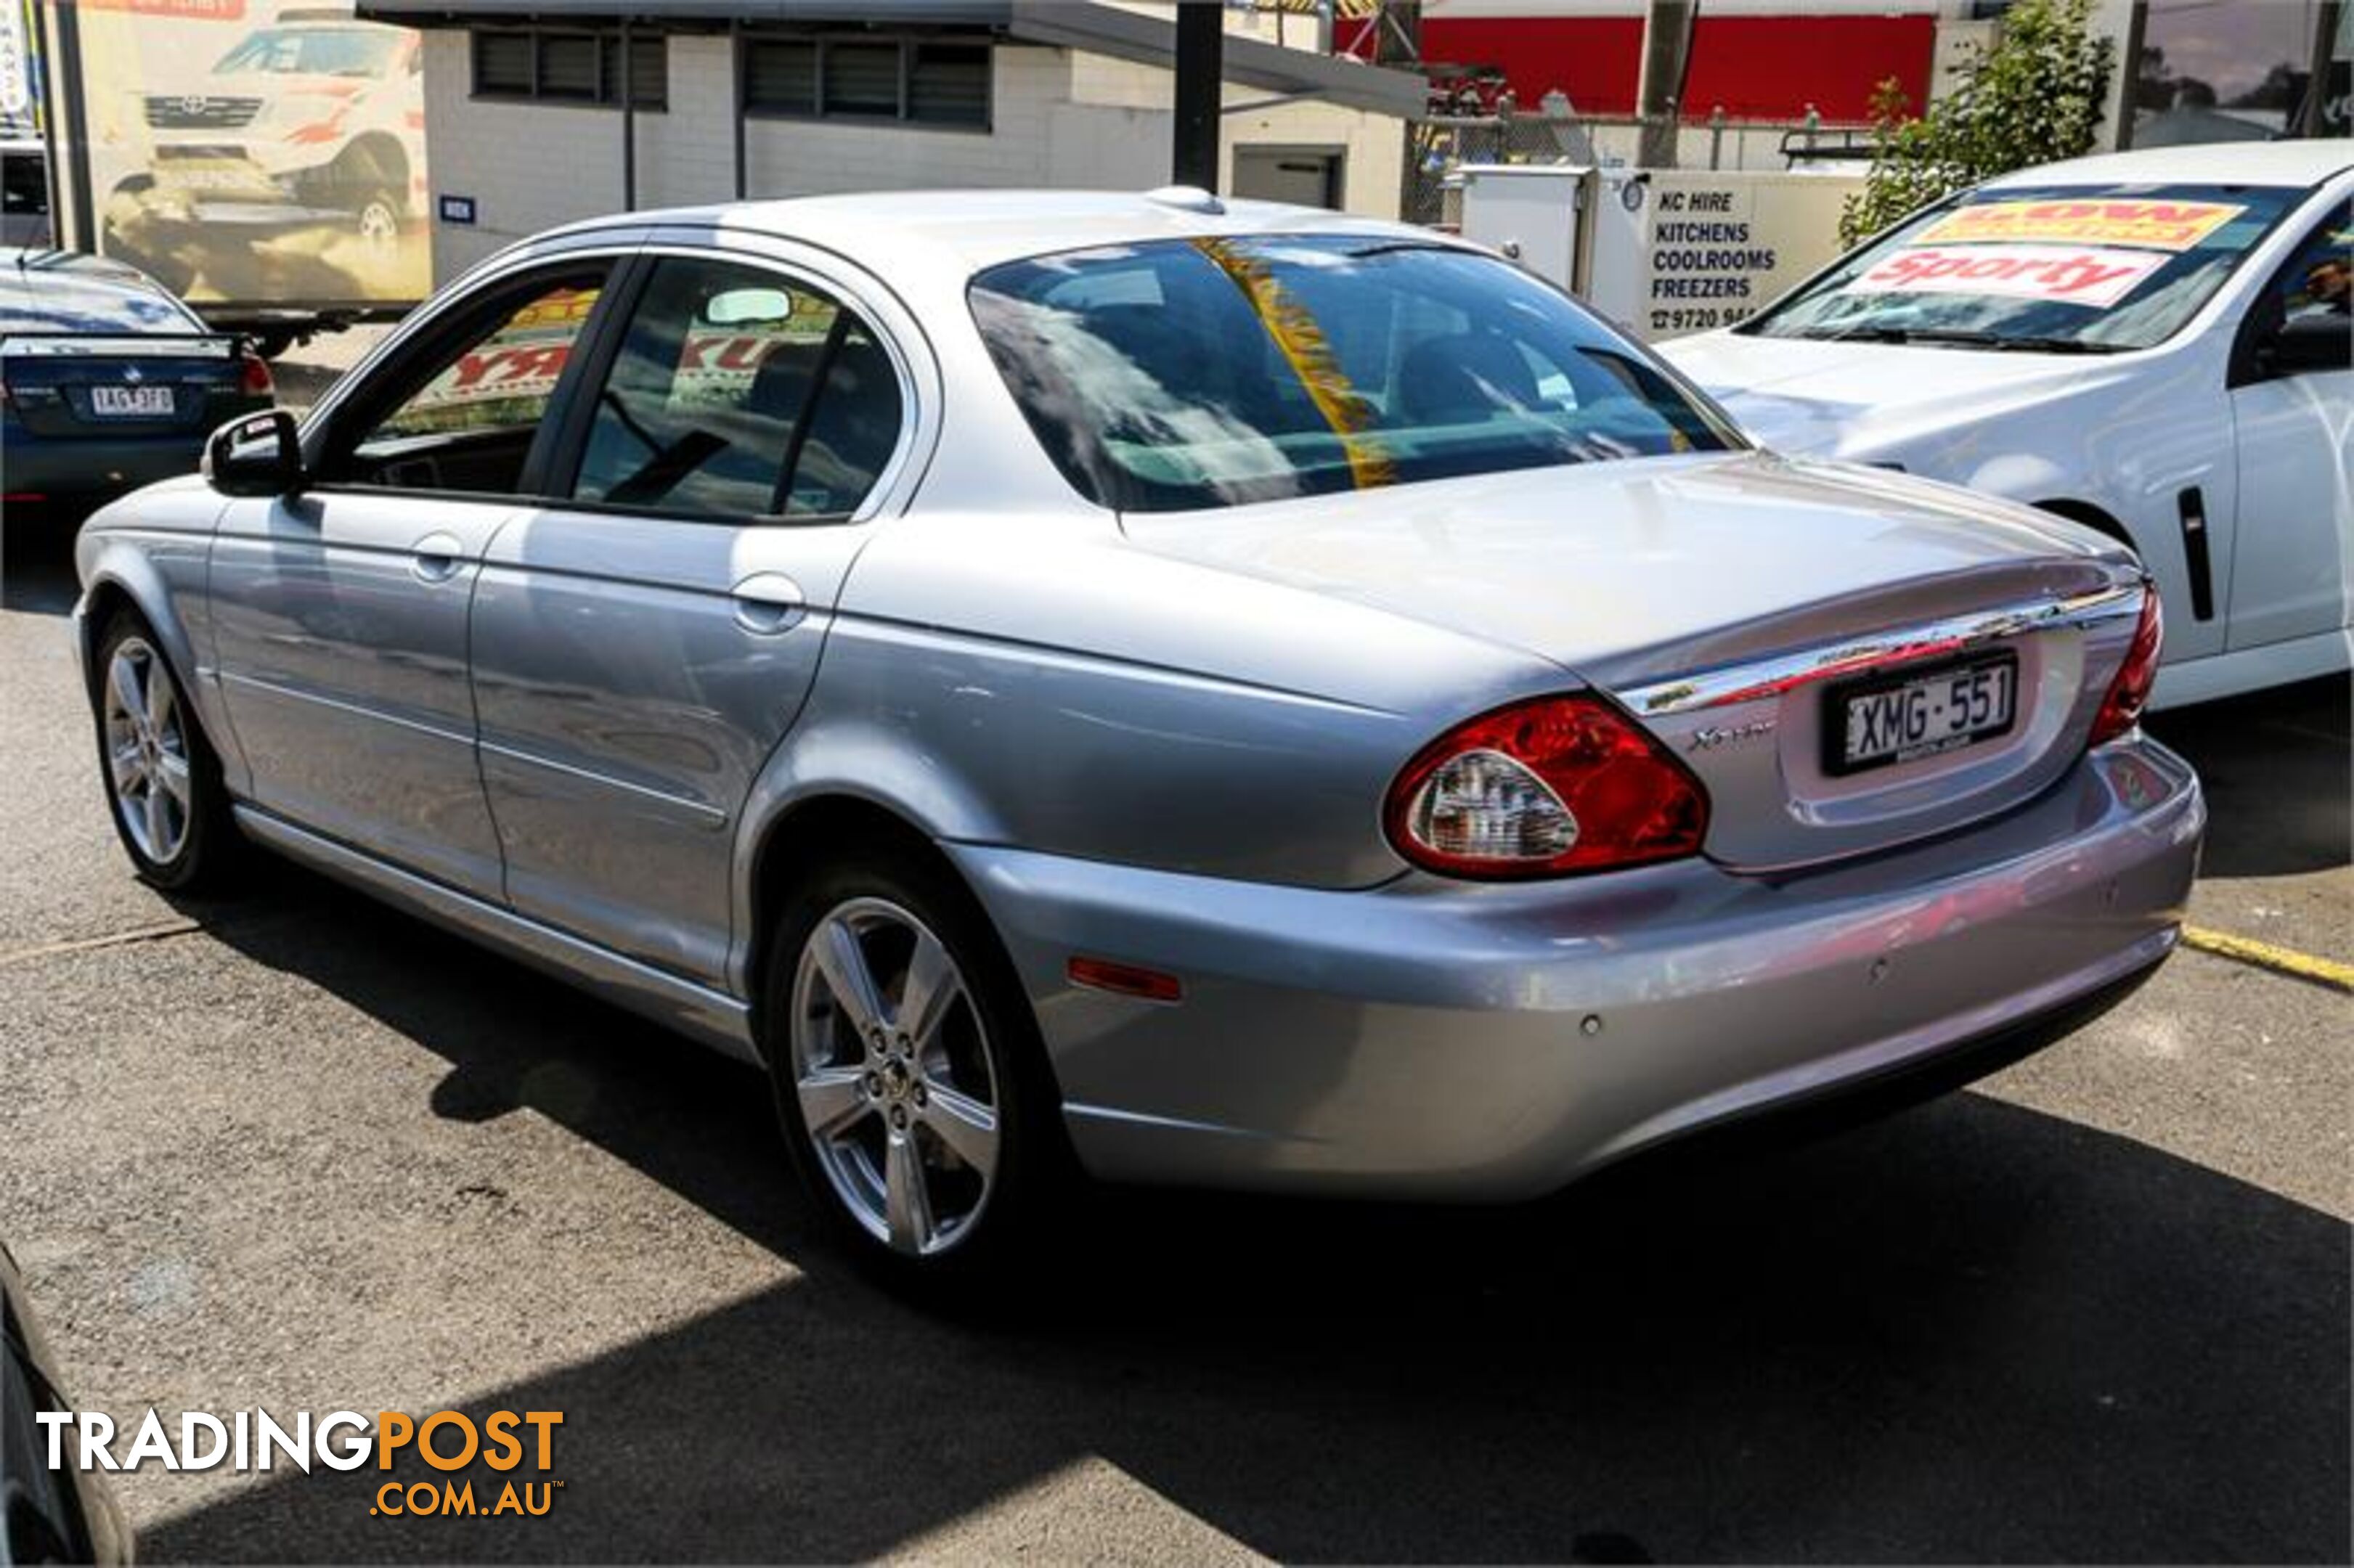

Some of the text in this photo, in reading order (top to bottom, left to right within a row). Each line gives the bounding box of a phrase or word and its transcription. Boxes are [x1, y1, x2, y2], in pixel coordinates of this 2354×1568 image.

[1658, 192, 1734, 212] KC HIRE
[1655, 222, 1749, 242] KITCHENS
[1653, 248, 1776, 271] COOLROOMS
[1870, 251, 2138, 295] Sporty
[1650, 277, 1751, 298] FREEZERS
[1671, 308, 1719, 327] 9720
